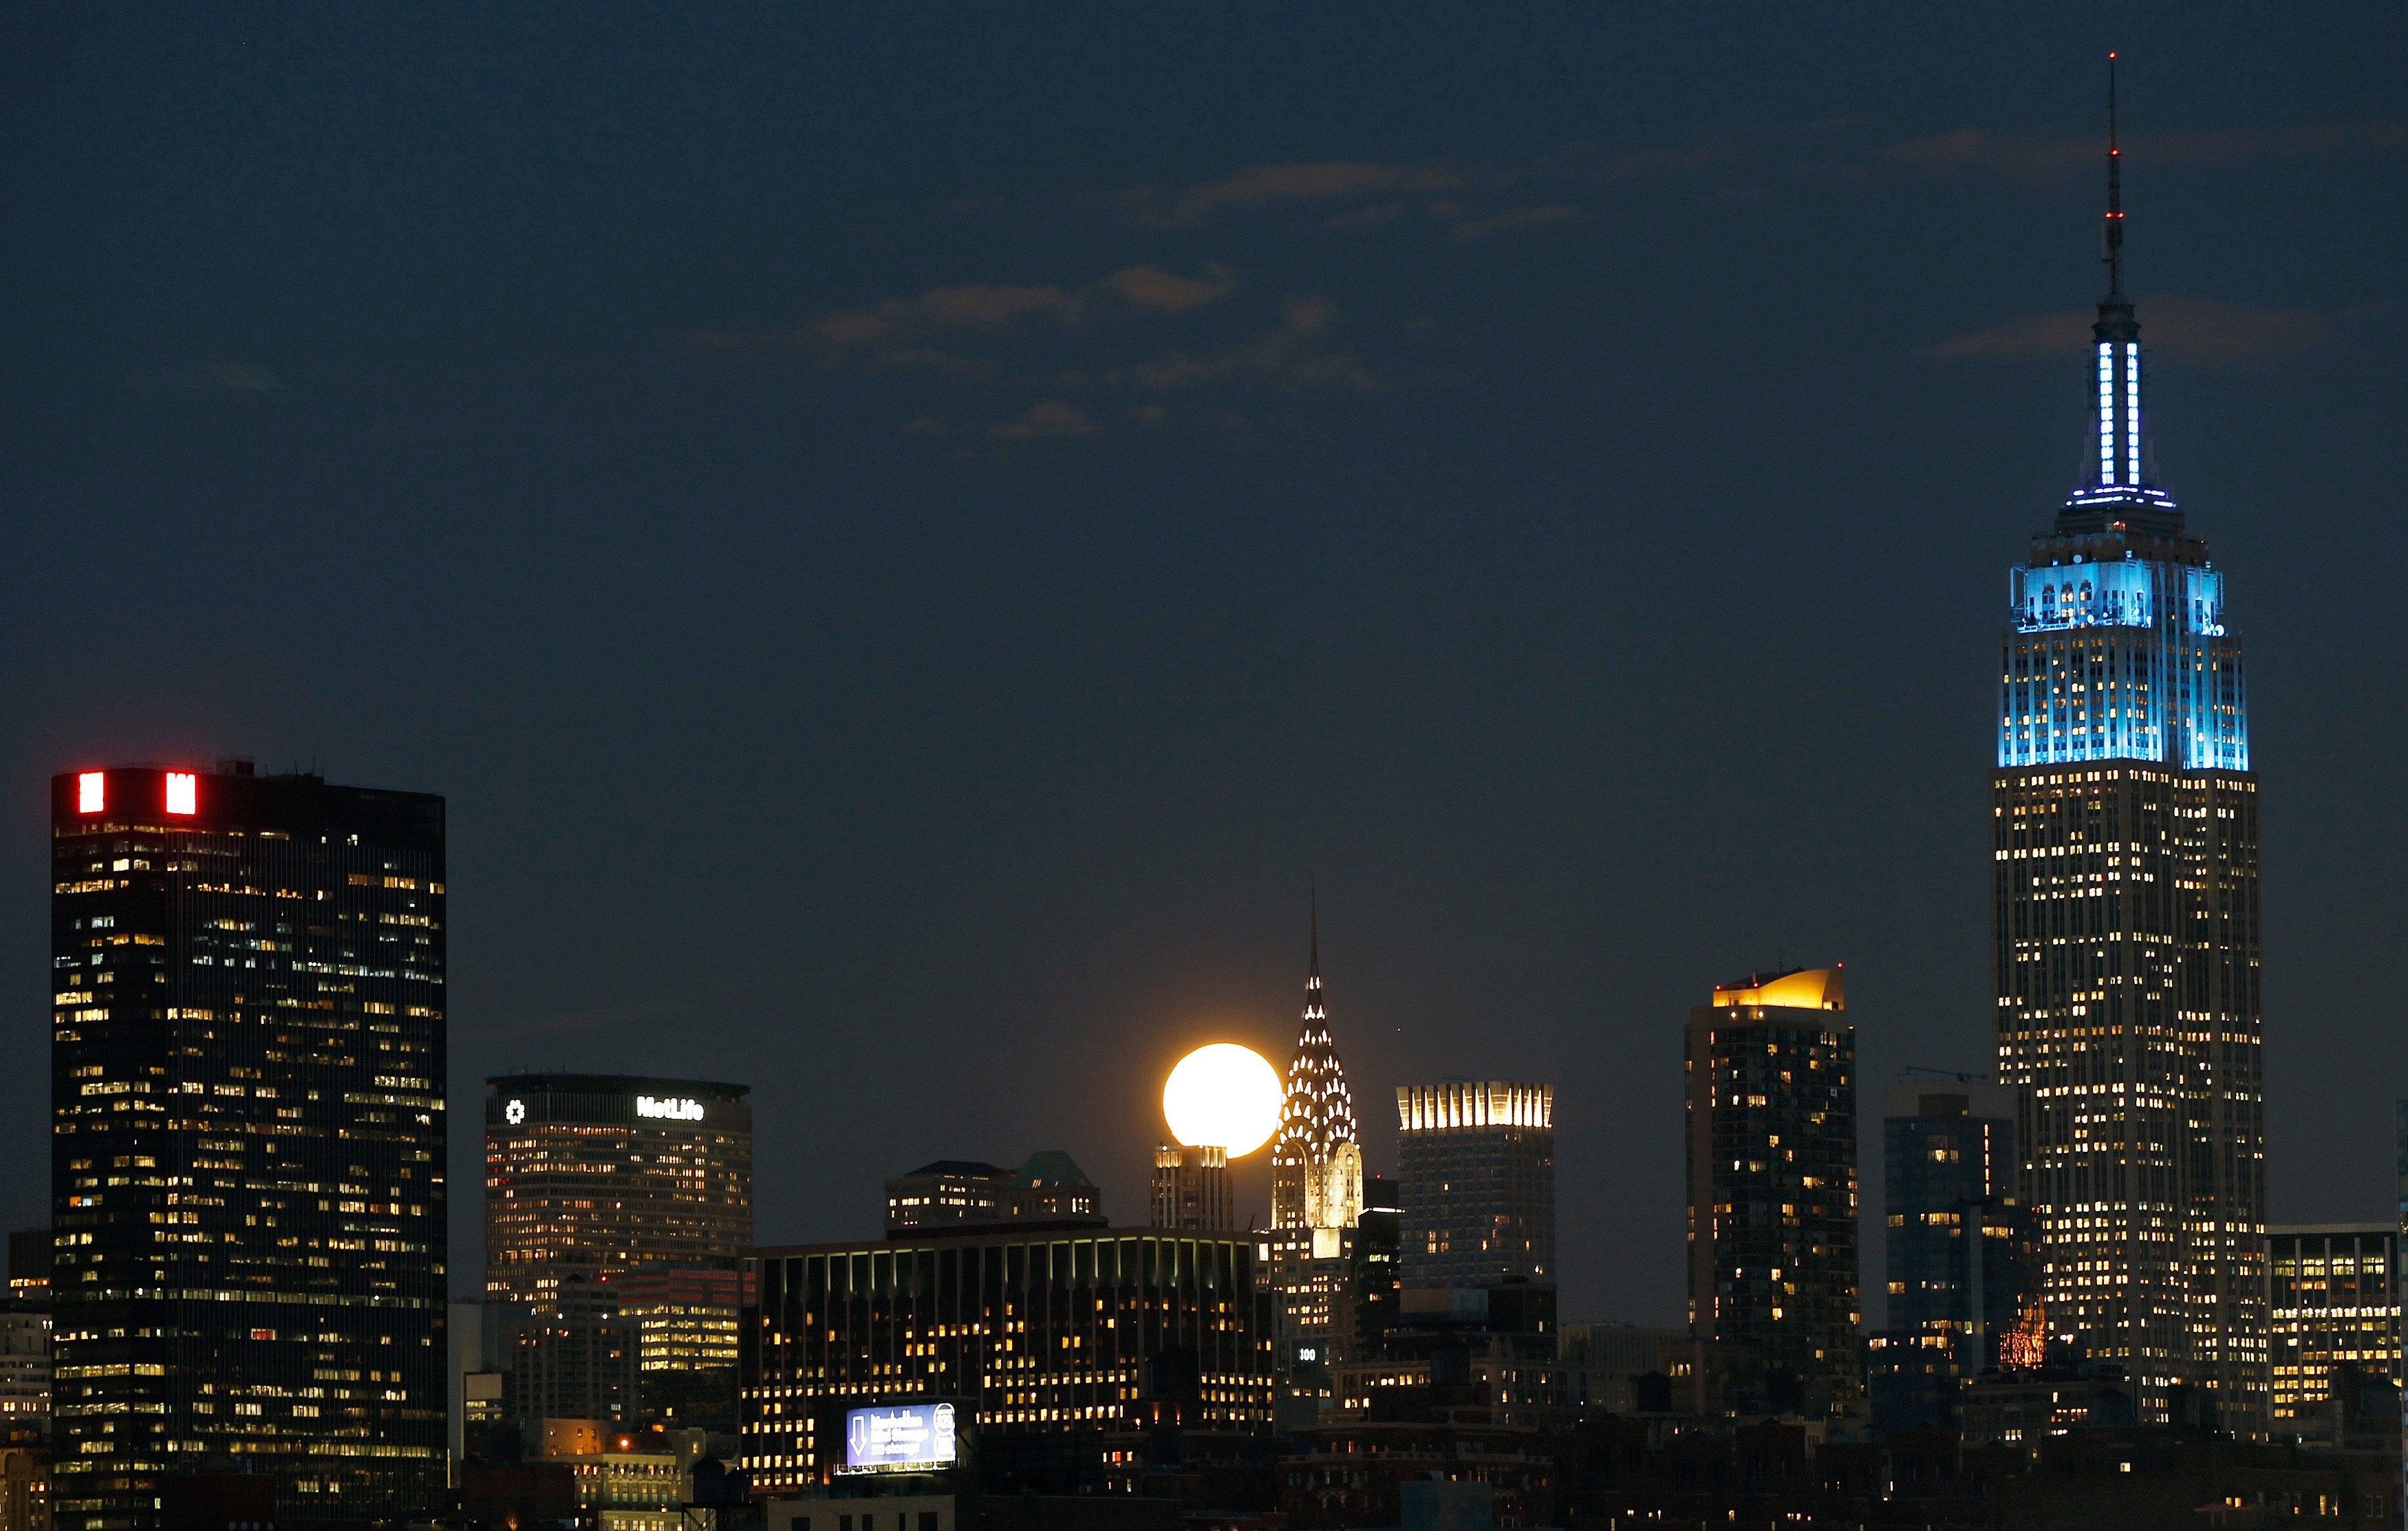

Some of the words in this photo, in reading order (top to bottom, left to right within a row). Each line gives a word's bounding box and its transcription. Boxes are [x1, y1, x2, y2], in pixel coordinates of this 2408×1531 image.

[636, 1095, 705, 1122] MetLife
[1300, 1347, 1316, 1361] 100
[871, 1410, 923, 1429] Manhattan
[871, 1428, 891, 1443] Mini
[892, 1428, 929, 1443] Storage
